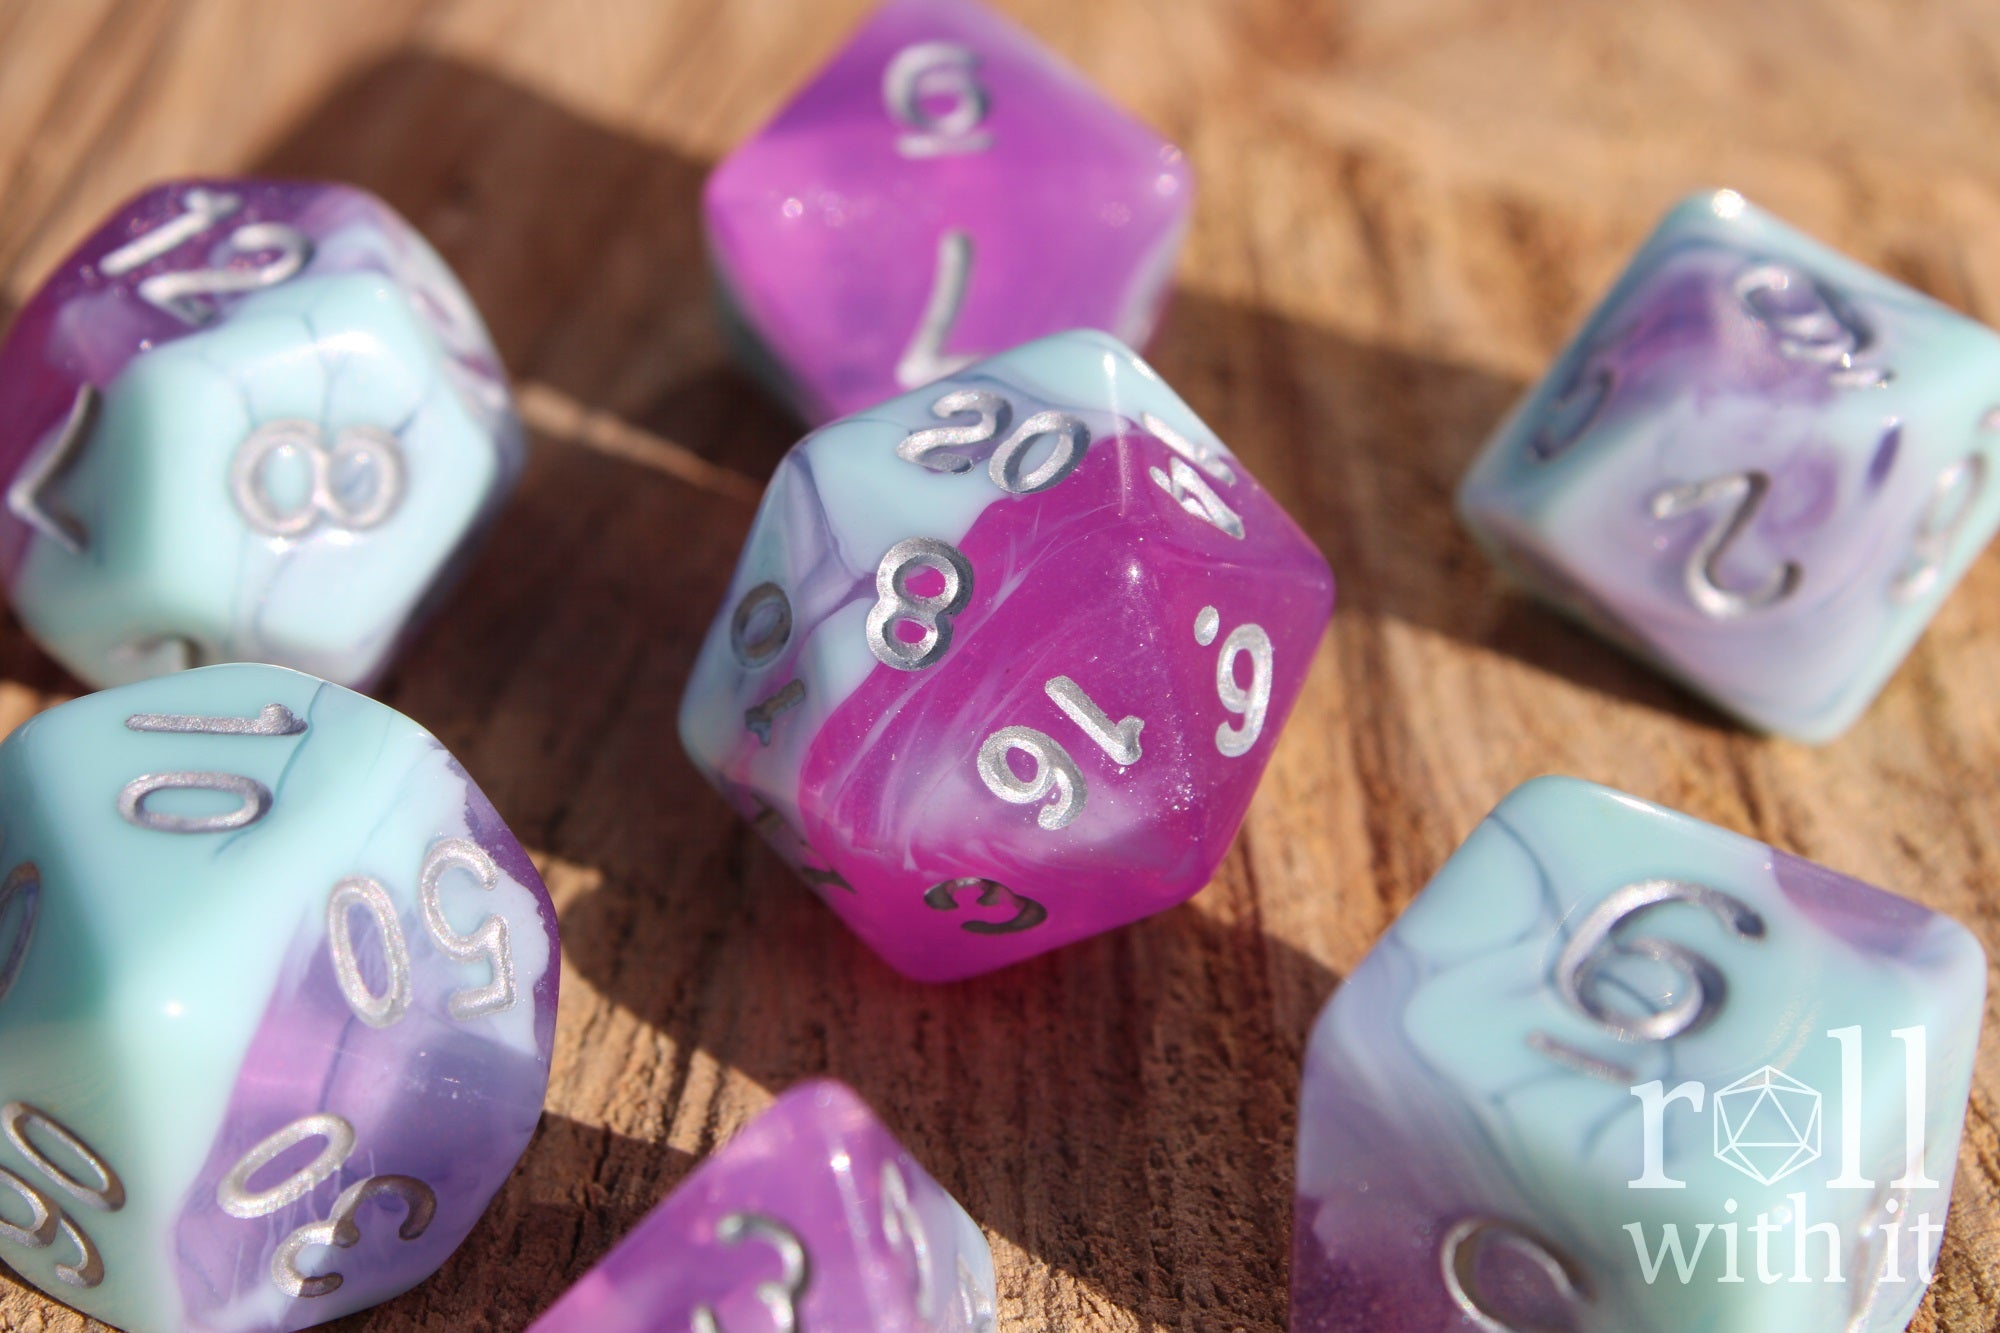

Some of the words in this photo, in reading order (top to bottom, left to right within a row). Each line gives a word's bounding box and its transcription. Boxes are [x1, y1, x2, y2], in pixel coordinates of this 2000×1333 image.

[99, 190, 313, 326] 12
[229, 419, 410, 538] 8
[898, 389, 1092, 494] 20
[866, 536, 974, 671] 8
[1645, 458, 1806, 618] 2
[117, 702, 309, 834] 10
[976, 675, 1145, 831] 16
[325, 837, 518, 1029] 50
[216, 1112, 437, 1298] 30
